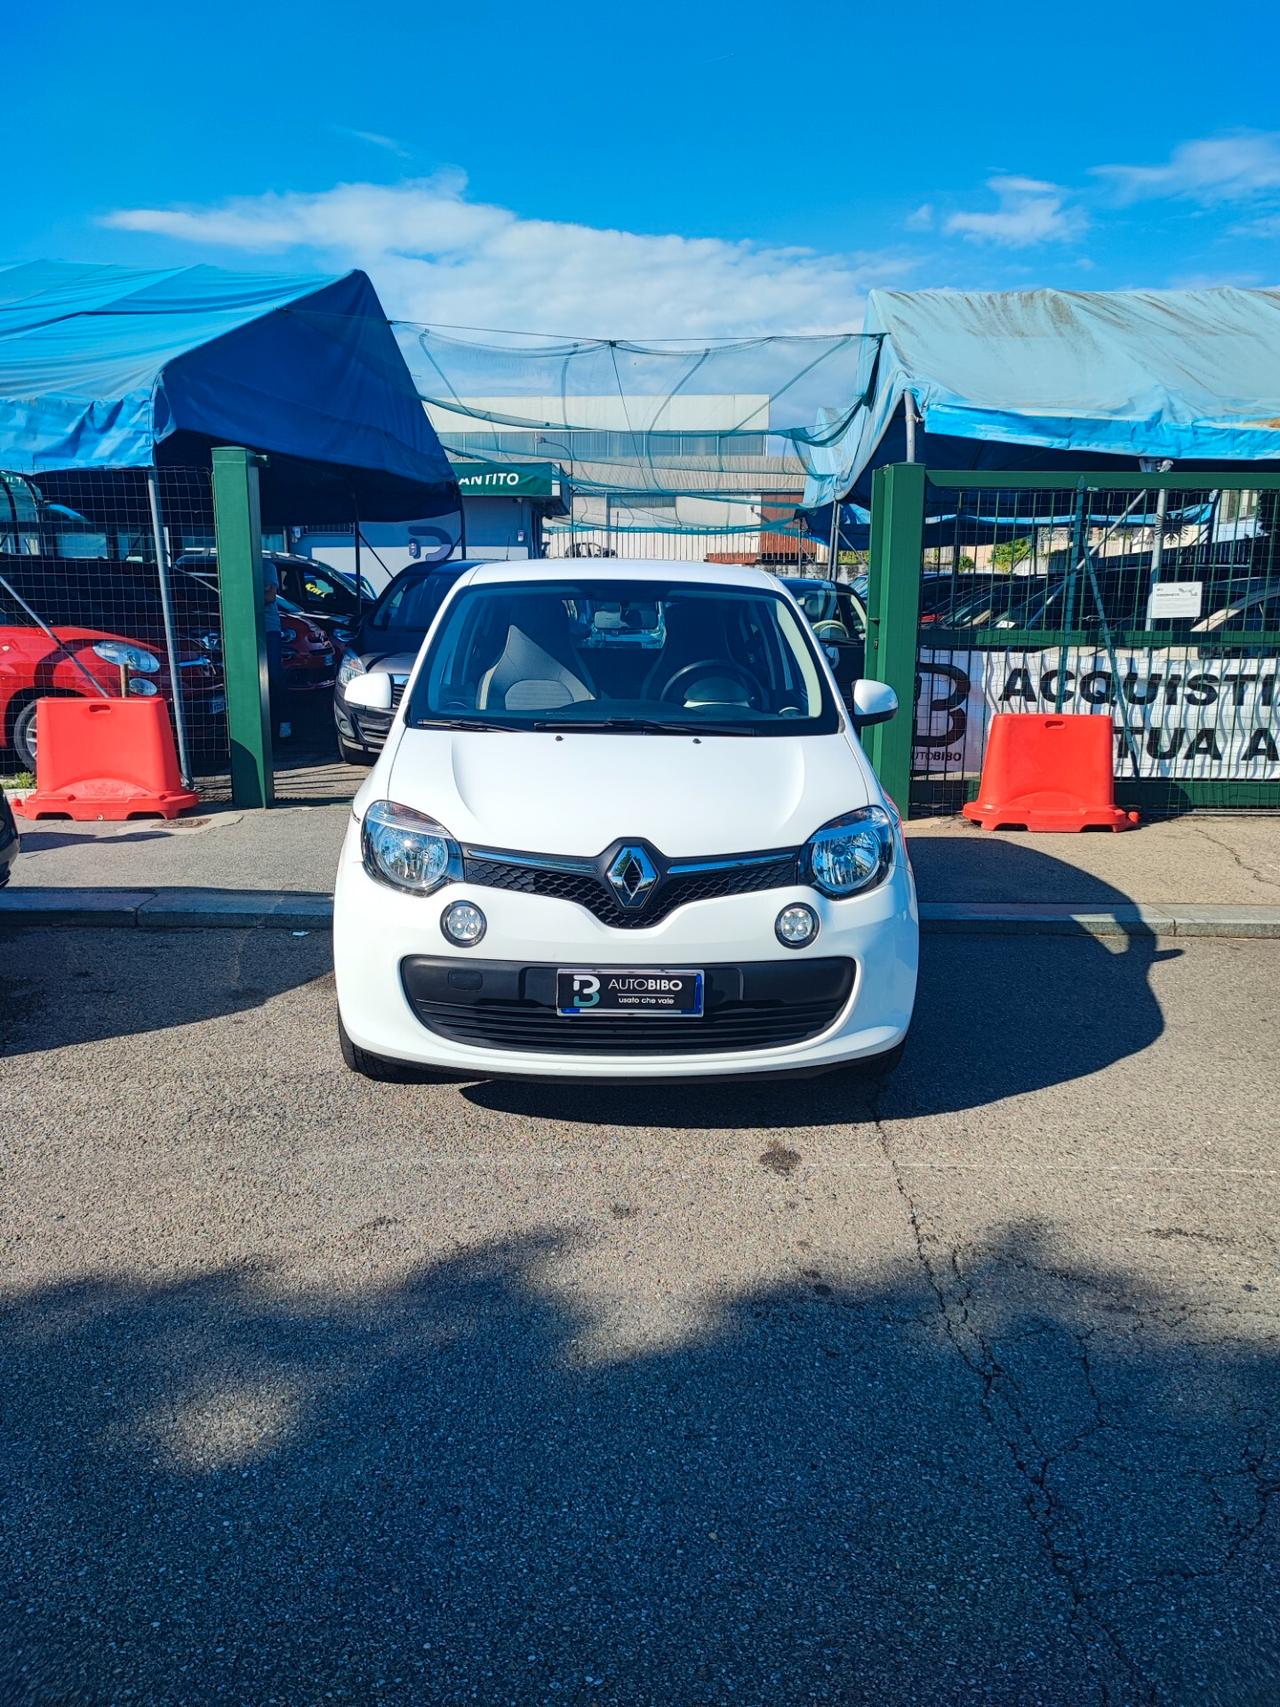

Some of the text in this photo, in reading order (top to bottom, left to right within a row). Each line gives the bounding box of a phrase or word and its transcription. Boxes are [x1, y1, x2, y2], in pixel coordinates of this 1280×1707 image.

[458, 473, 519, 486] ANTITO
[998, 668, 1280, 706] ACQUISTI
[912, 751, 962, 762] UTOBIBO
[608, 978, 683, 991] AUTOBIBO
